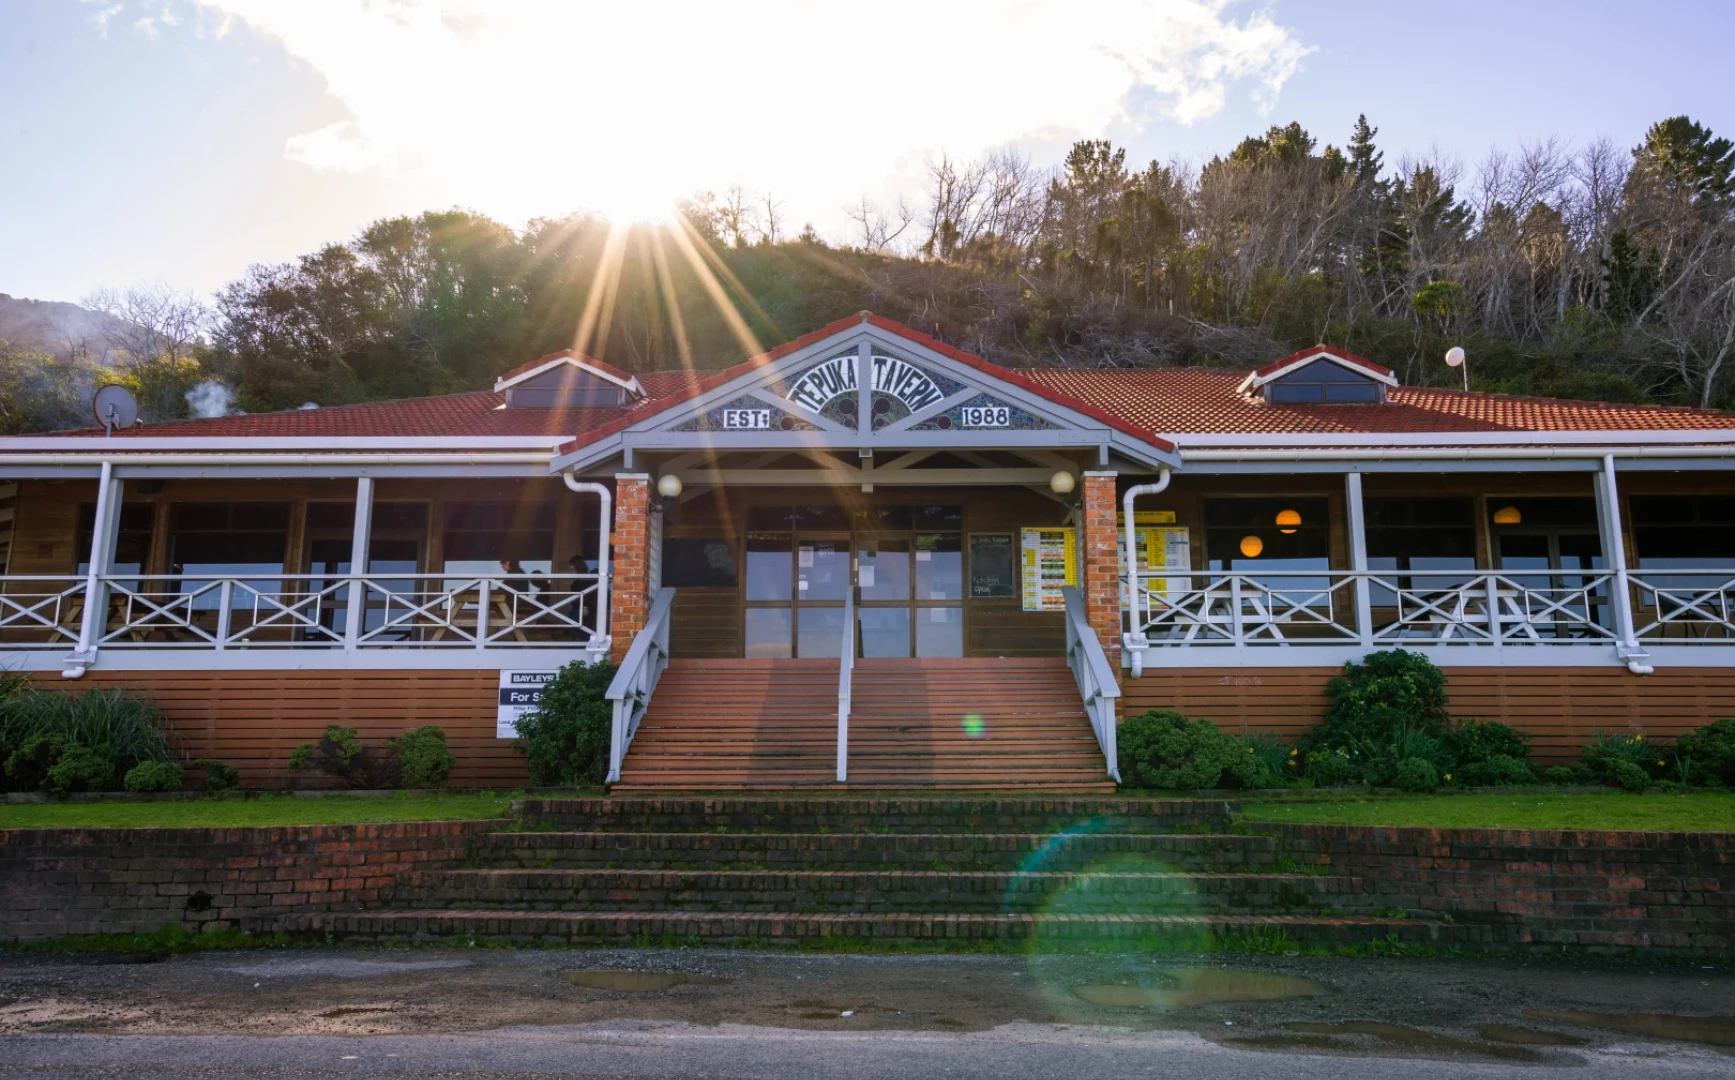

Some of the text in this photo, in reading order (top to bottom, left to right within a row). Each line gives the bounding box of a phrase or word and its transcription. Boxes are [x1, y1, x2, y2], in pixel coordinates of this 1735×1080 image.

[873, 358, 942, 413] TAVERN
[963, 408, 1008, 425] 1988
[513, 674, 555, 683] BAYLEYS
[510, 692, 530, 702] For
